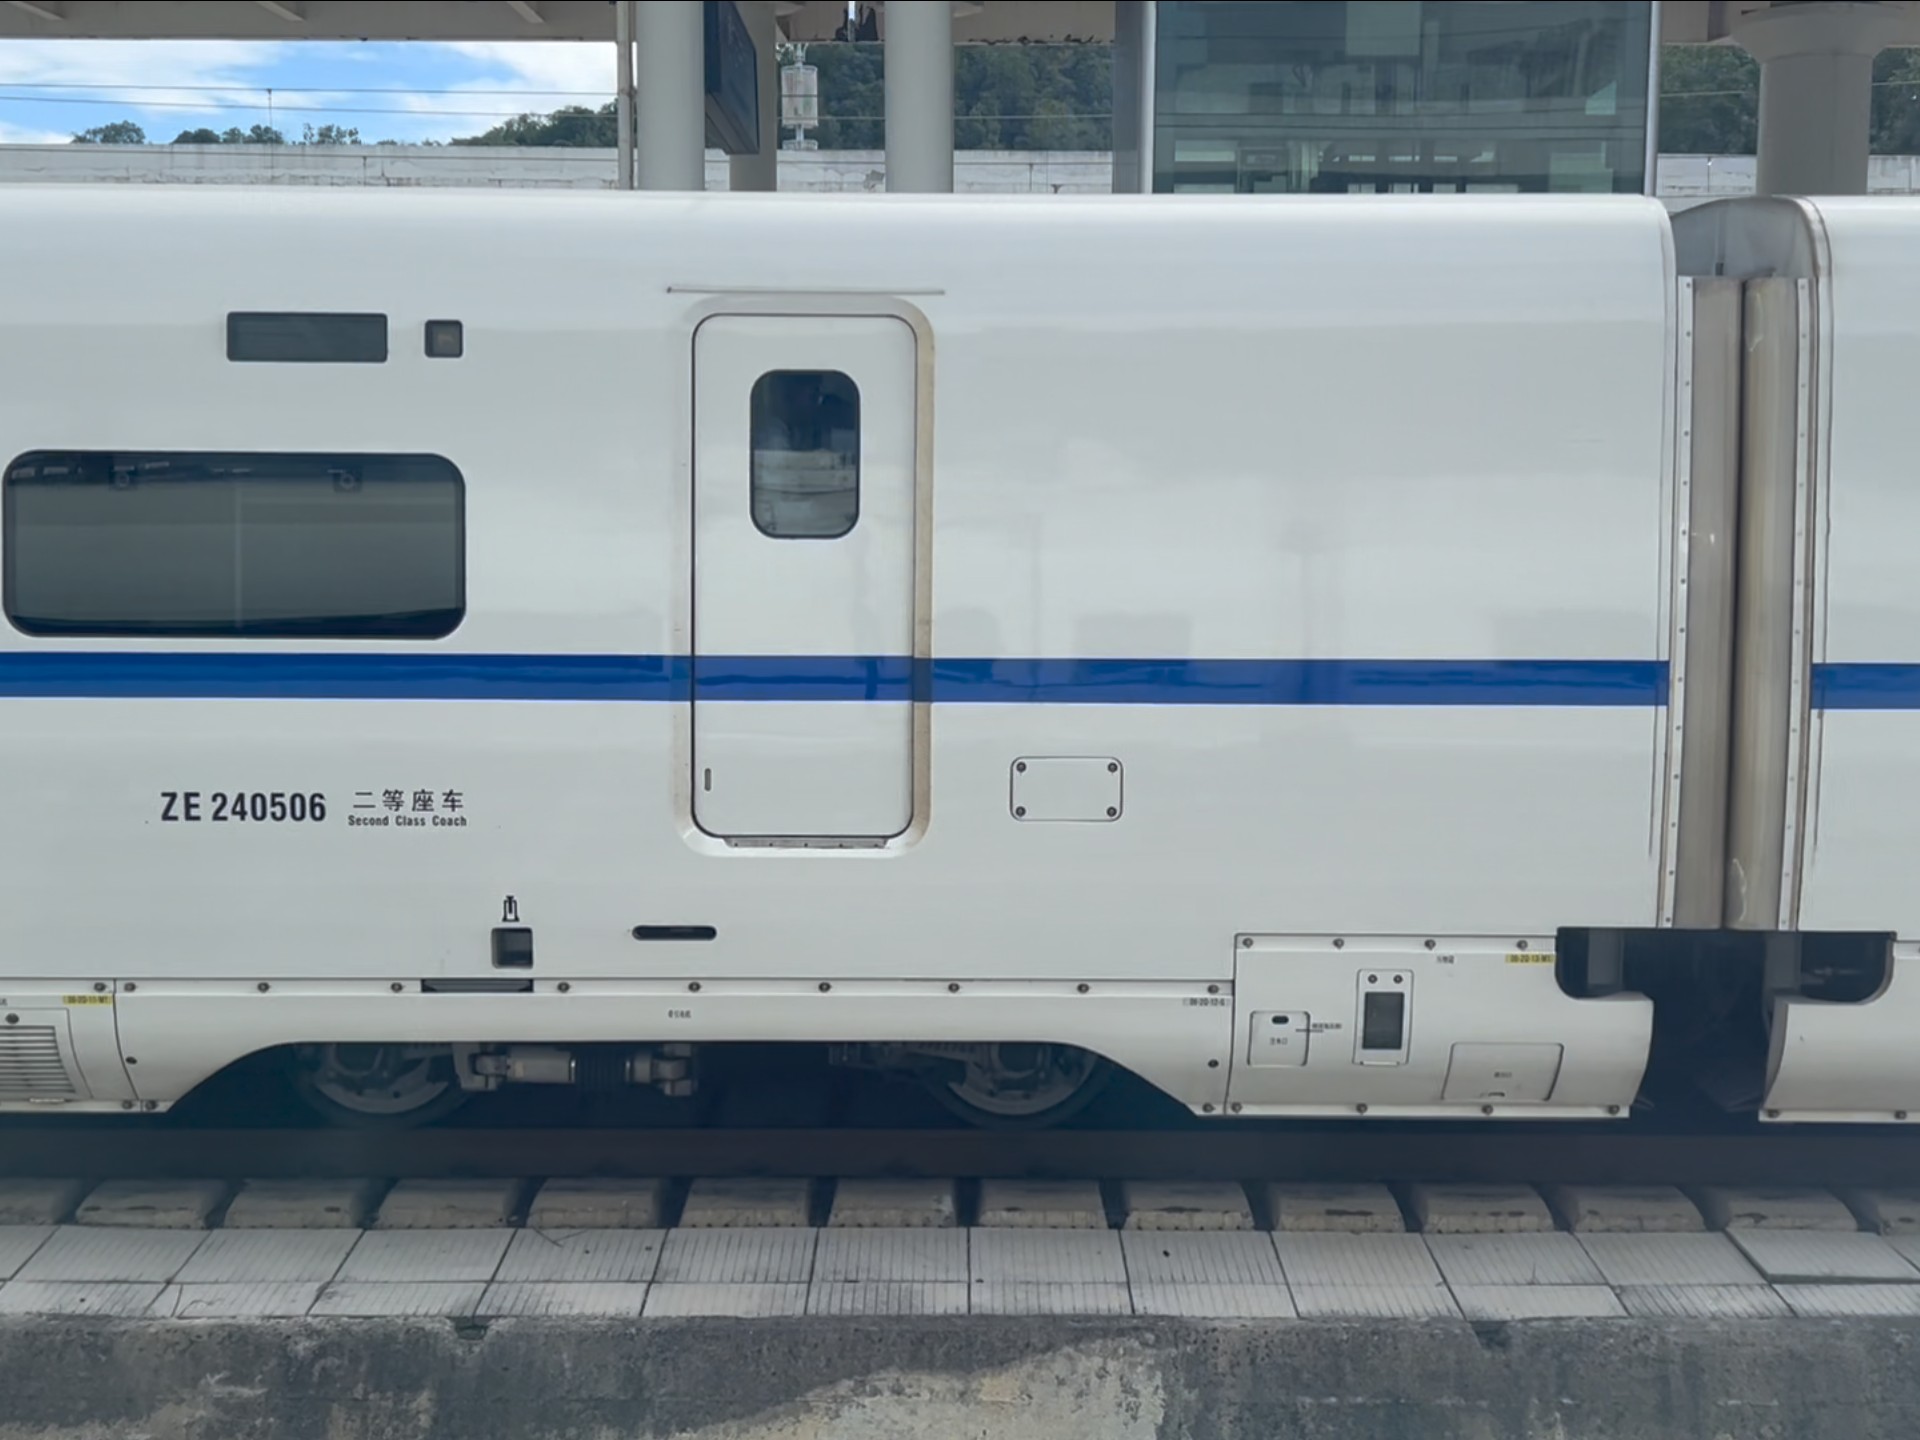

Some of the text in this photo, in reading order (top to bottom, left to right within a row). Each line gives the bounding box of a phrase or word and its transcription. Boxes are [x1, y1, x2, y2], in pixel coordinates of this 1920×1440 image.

[161, 792, 326, 822] ZE 240506
[353, 789, 463, 812] 二等座车
[348, 815, 466, 826] Second Class Coach
